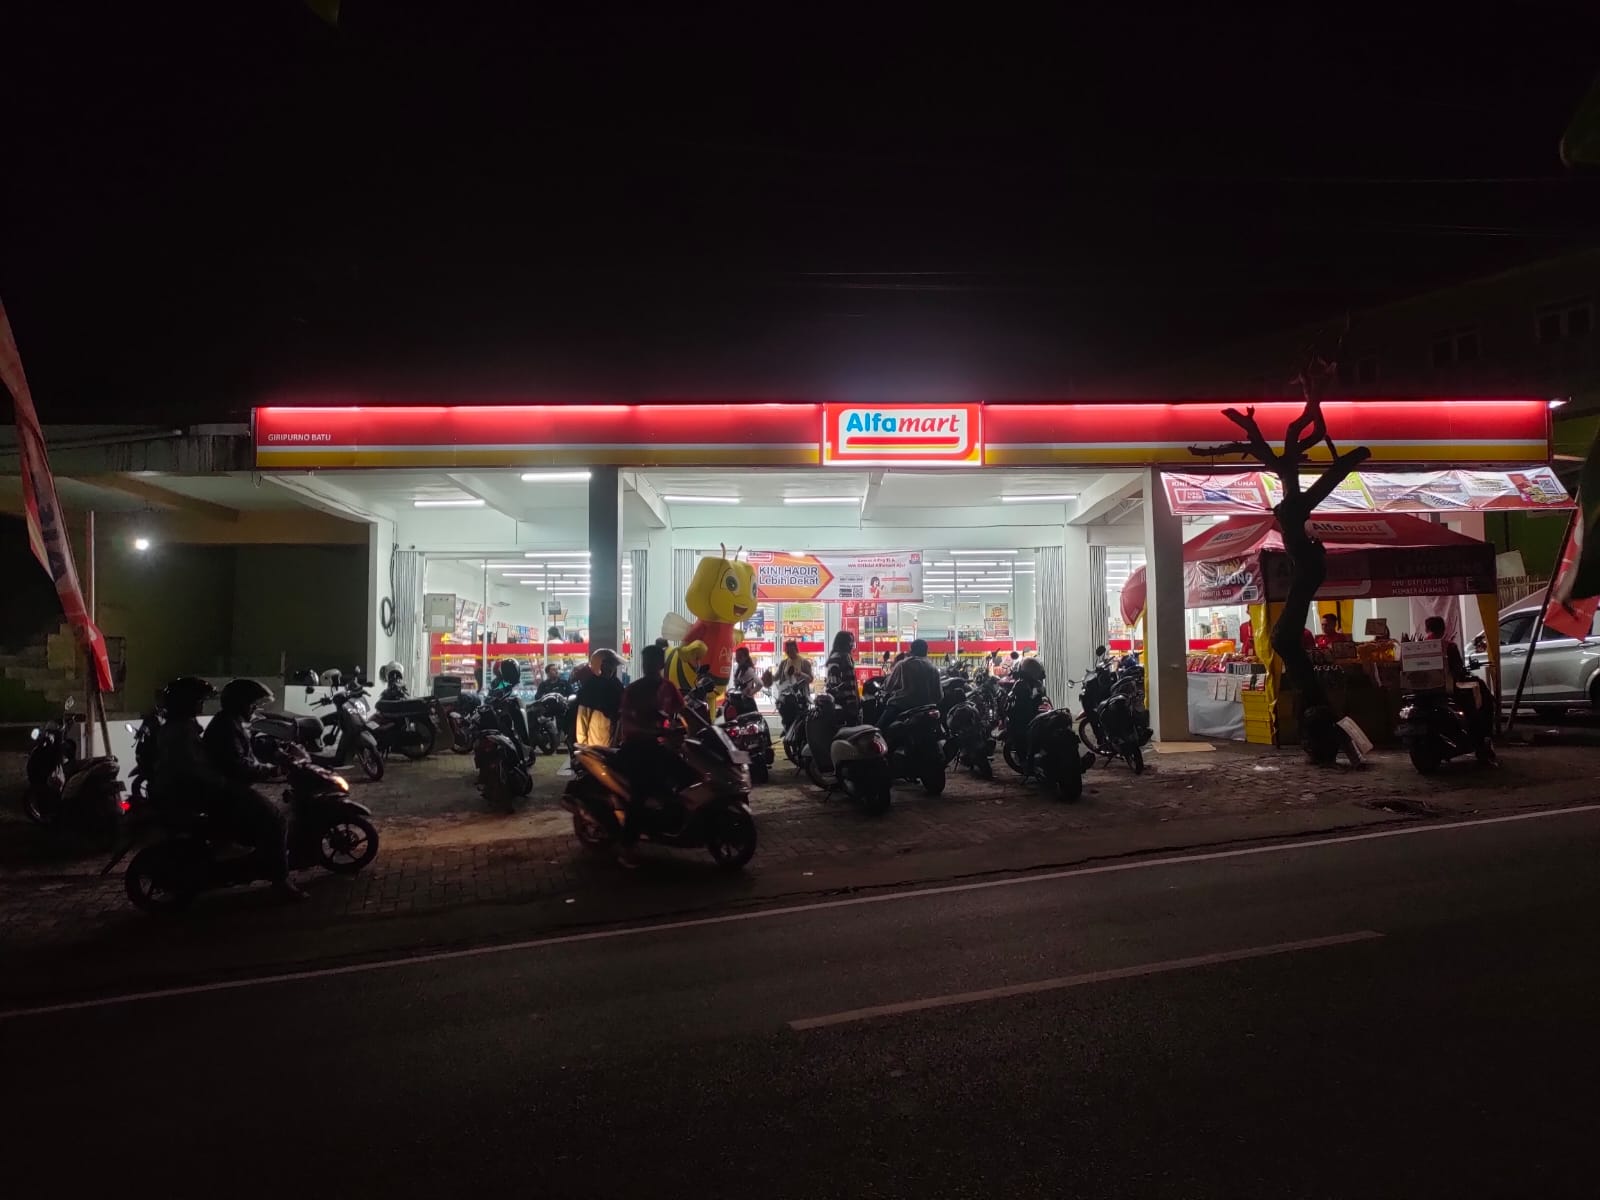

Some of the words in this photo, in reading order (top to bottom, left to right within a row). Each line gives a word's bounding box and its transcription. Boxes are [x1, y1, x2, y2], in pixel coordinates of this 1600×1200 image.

[846, 412, 960, 433] Alfamart
[268, 433, 310, 442] GIRIPURNO
[311, 433, 331, 442] BATU
[1312, 522, 1382, 533] Alfamart
[759, 566, 781, 576] KINI
[783, 566, 818, 576] HADIR
[759, 575, 787, 585] Lebih
[789, 575, 819, 585] Dekat
